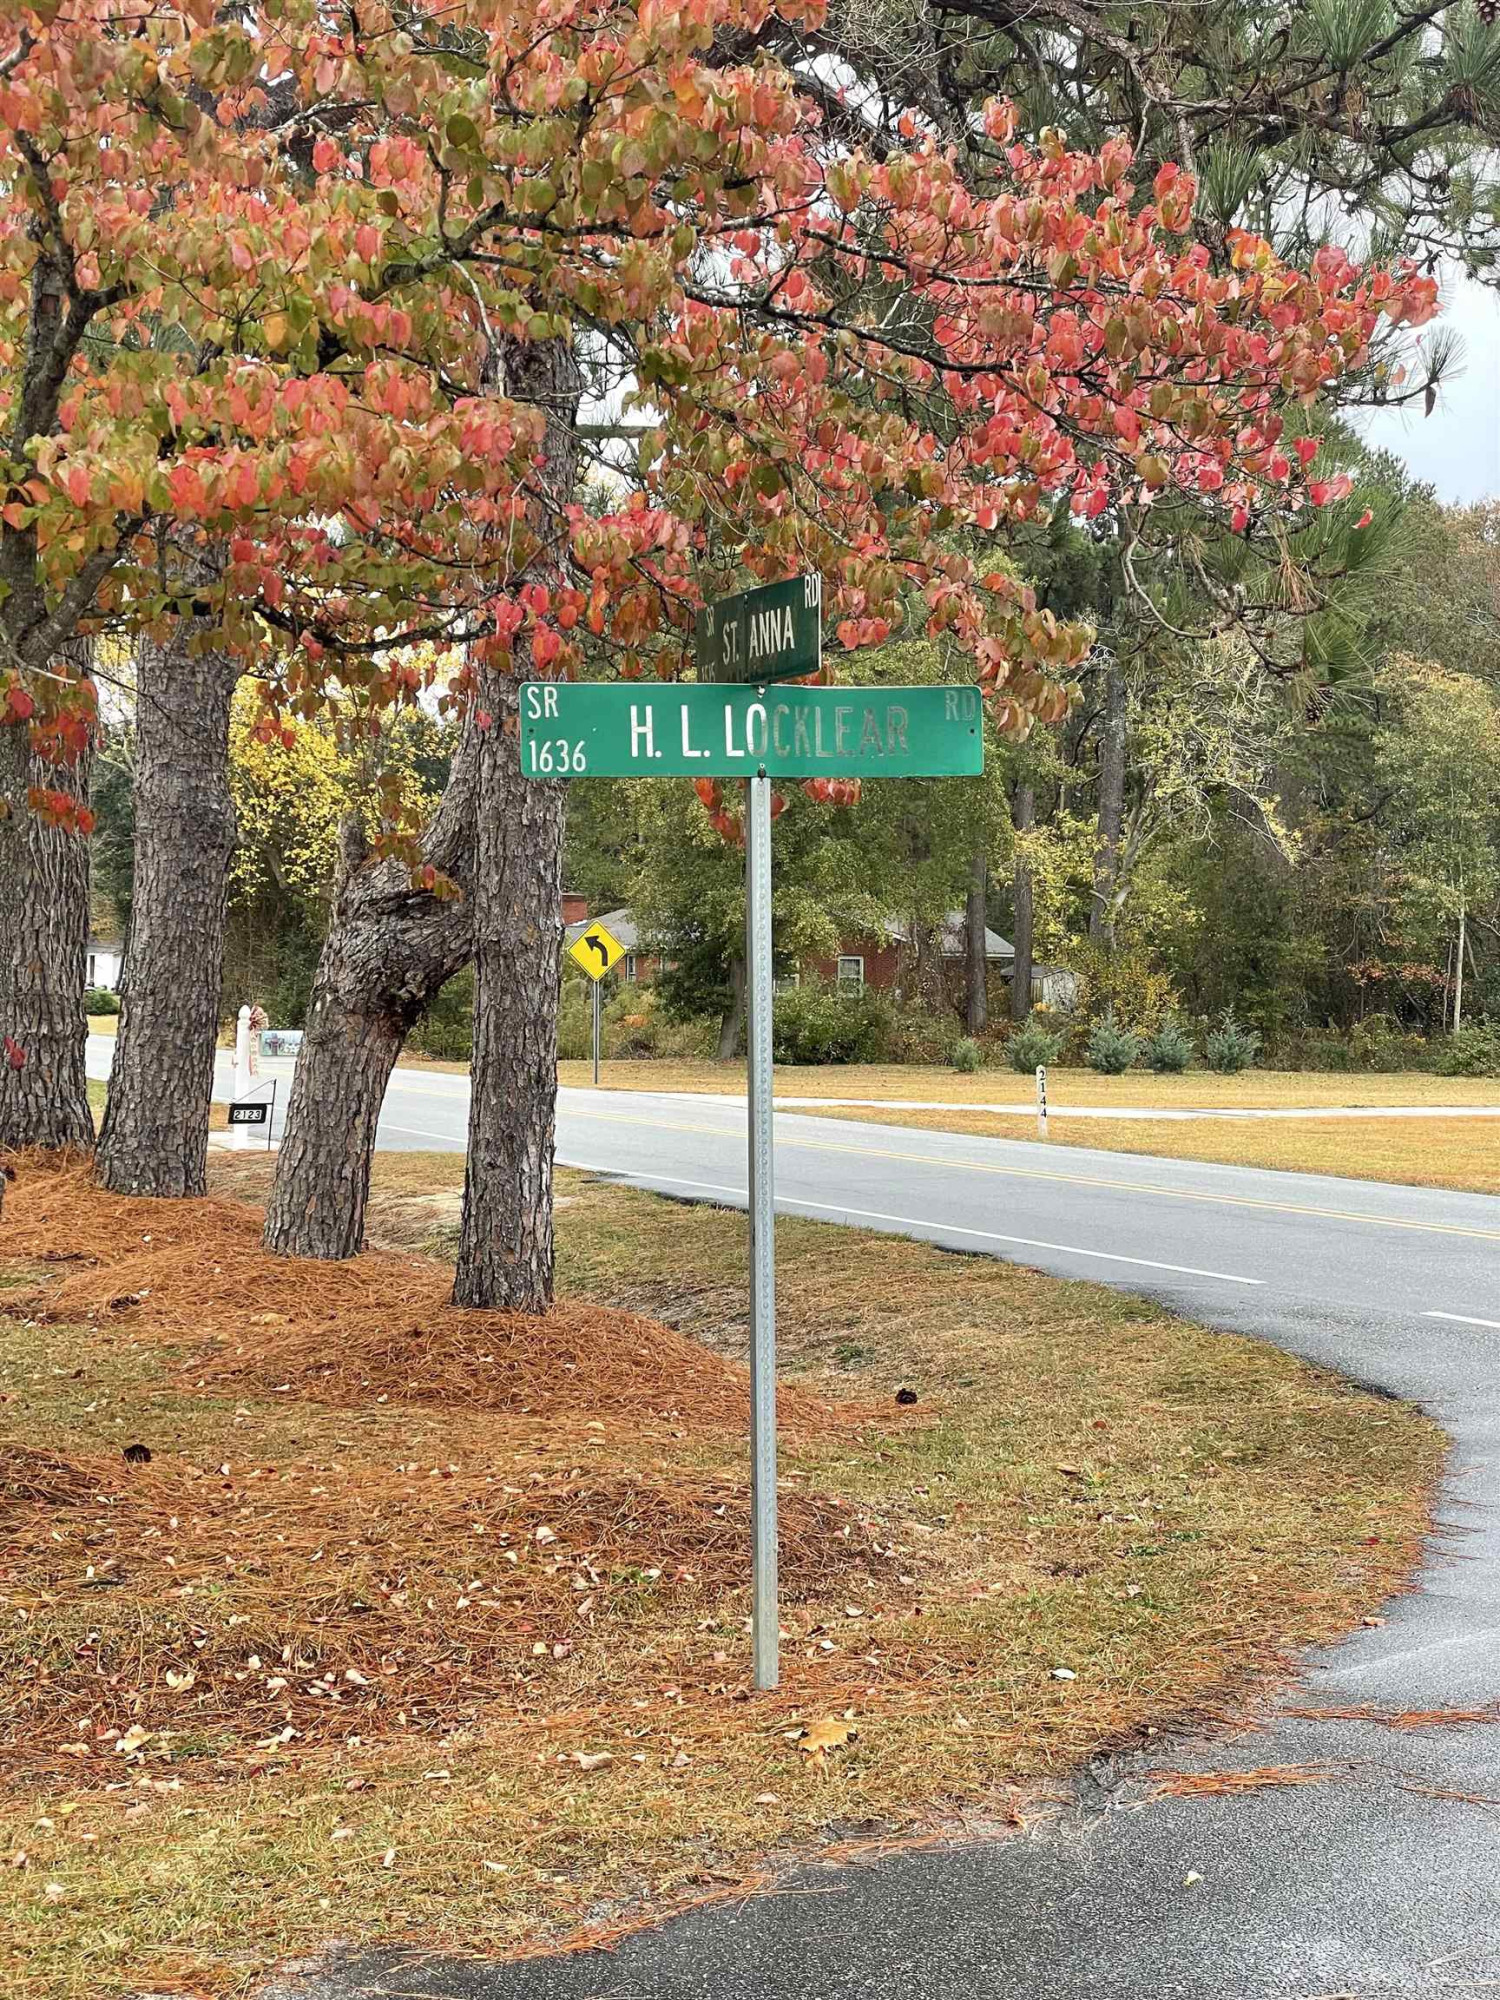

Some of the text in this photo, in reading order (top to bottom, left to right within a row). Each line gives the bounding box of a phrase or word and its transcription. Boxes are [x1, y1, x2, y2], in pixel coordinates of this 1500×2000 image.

[805, 573, 819, 609] RD
[722, 605, 796, 665] ST. ANNA
[527, 686, 559, 719] SR
[945, 690, 976, 721] RD
[630, 703, 909, 758] H. L. LOCKLEAR
[528, 739, 586, 772] 1636
[1039, 1070, 1047, 1118] 2144
[234, 1111, 260, 1119] 2123
